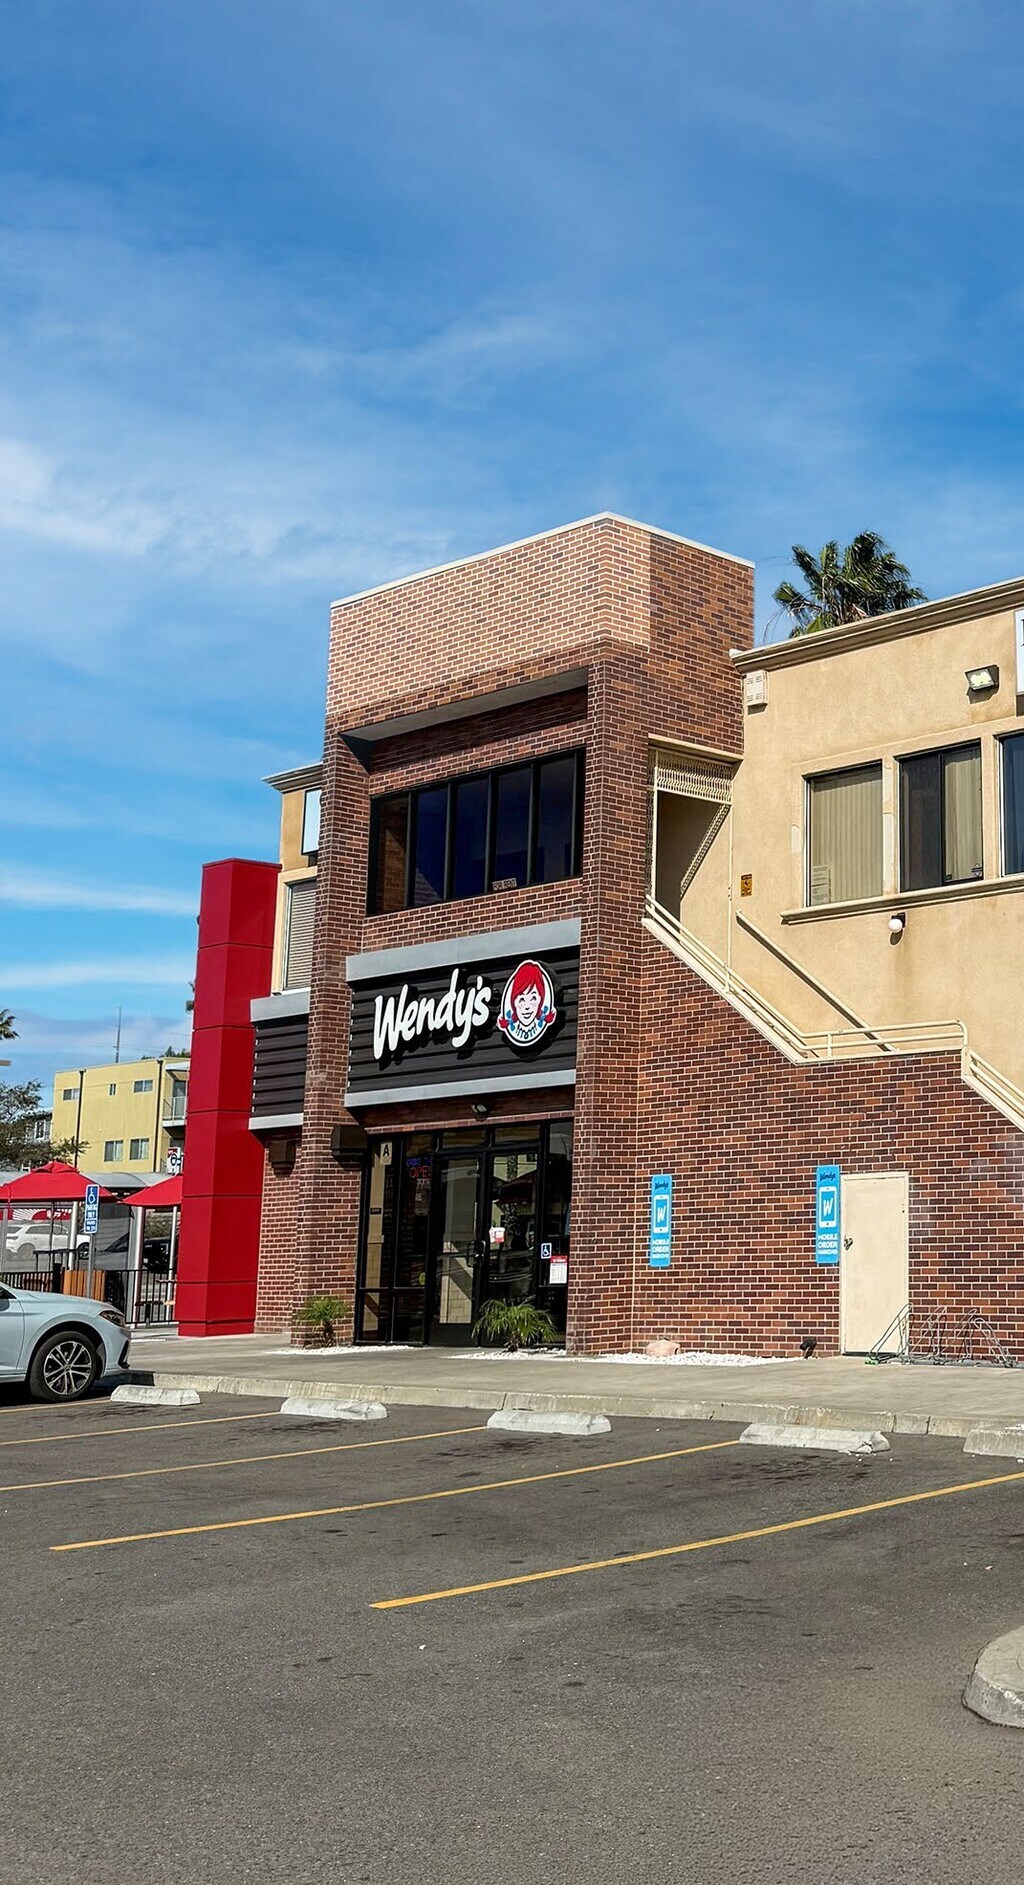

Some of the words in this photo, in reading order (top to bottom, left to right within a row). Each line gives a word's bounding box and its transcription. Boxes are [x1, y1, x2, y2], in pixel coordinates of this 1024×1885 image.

[373, 968, 492, 1060] Wendy's
[383, 1144, 389, 1157] A
[657, 1205, 667, 1223] W
[823, 1197, 833, 1217] W
